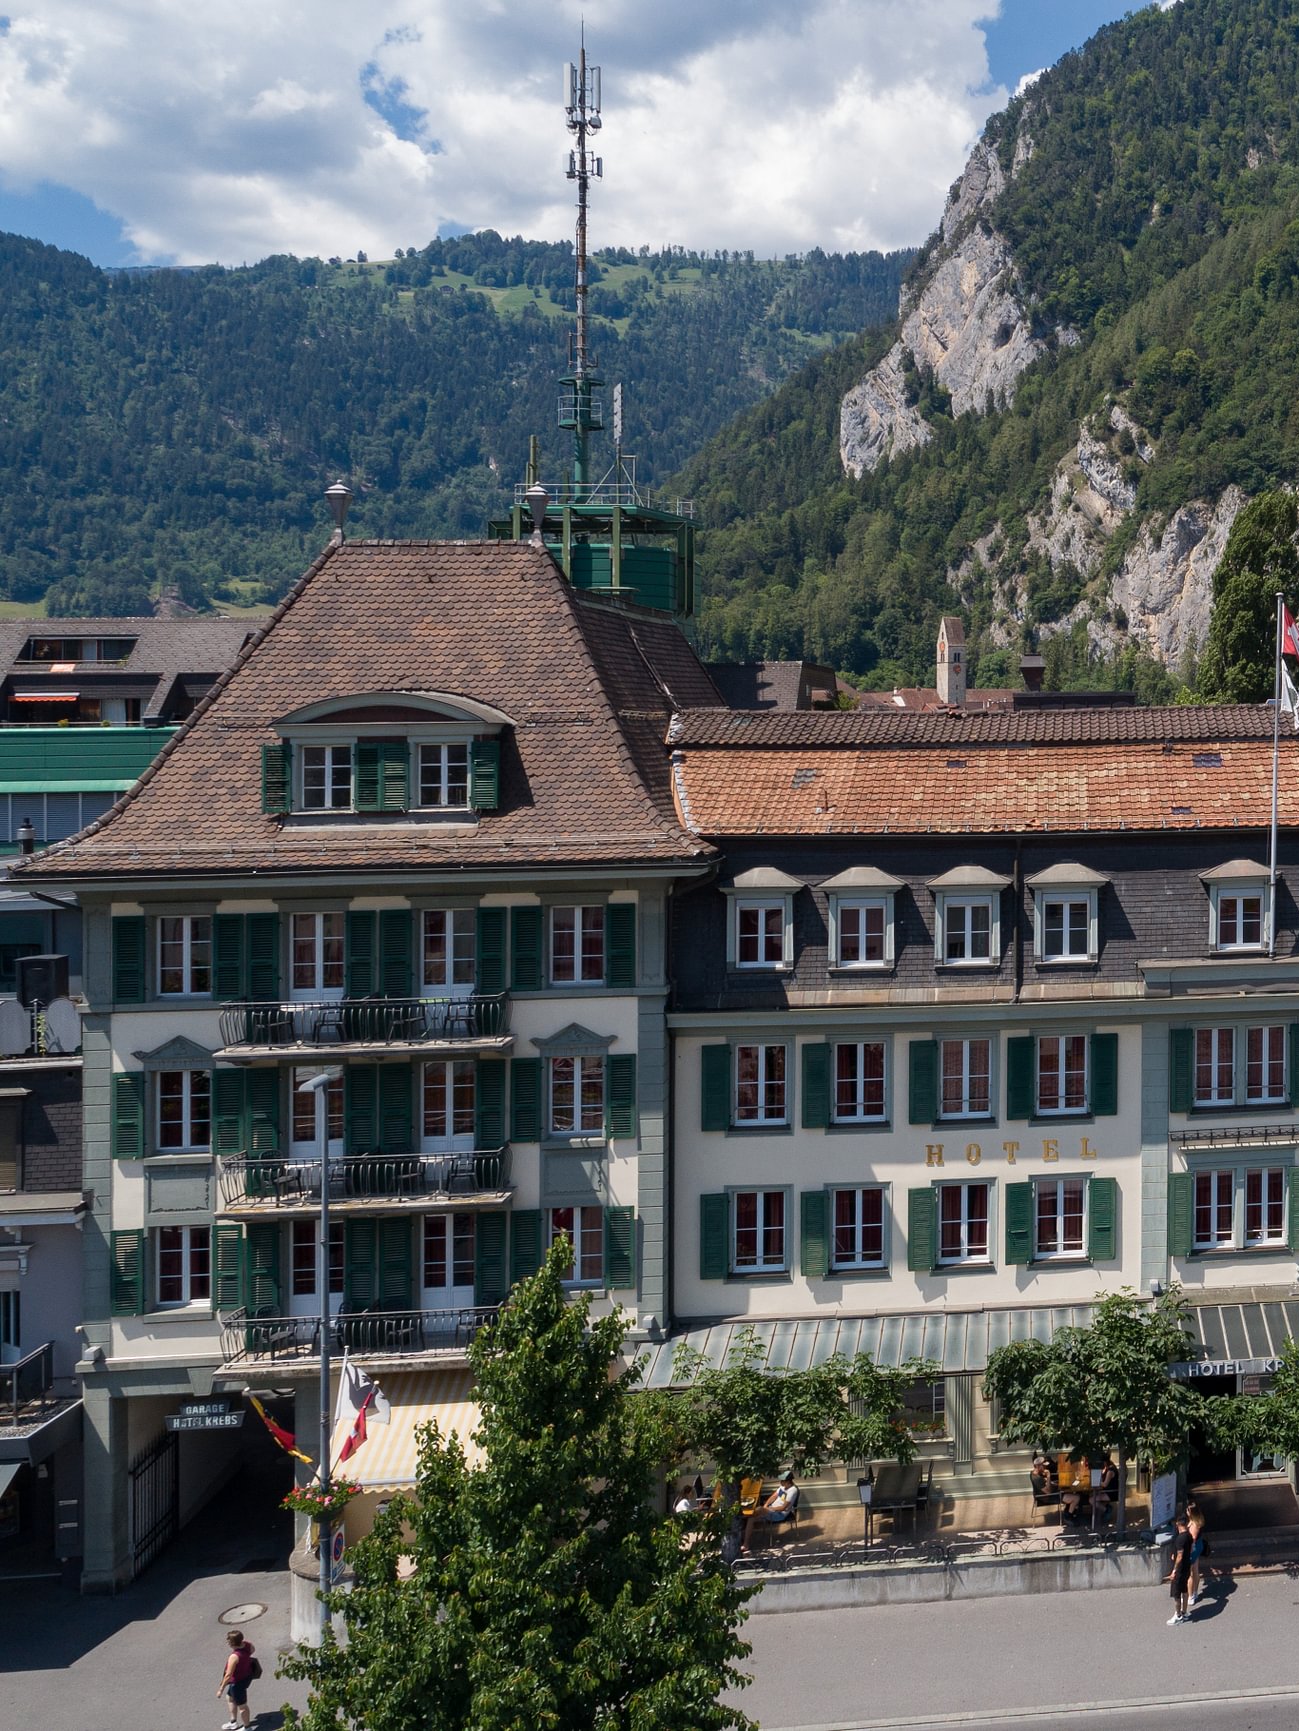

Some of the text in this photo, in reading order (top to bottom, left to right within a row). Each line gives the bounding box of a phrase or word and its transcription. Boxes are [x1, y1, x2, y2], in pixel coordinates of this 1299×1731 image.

[925, 1136, 1097, 1166] HOTEL
[1188, 1360, 1246, 1377] HOTEL
[185, 1404, 225, 1415] GARAGE
[205, 1415, 238, 1426] KREBS
